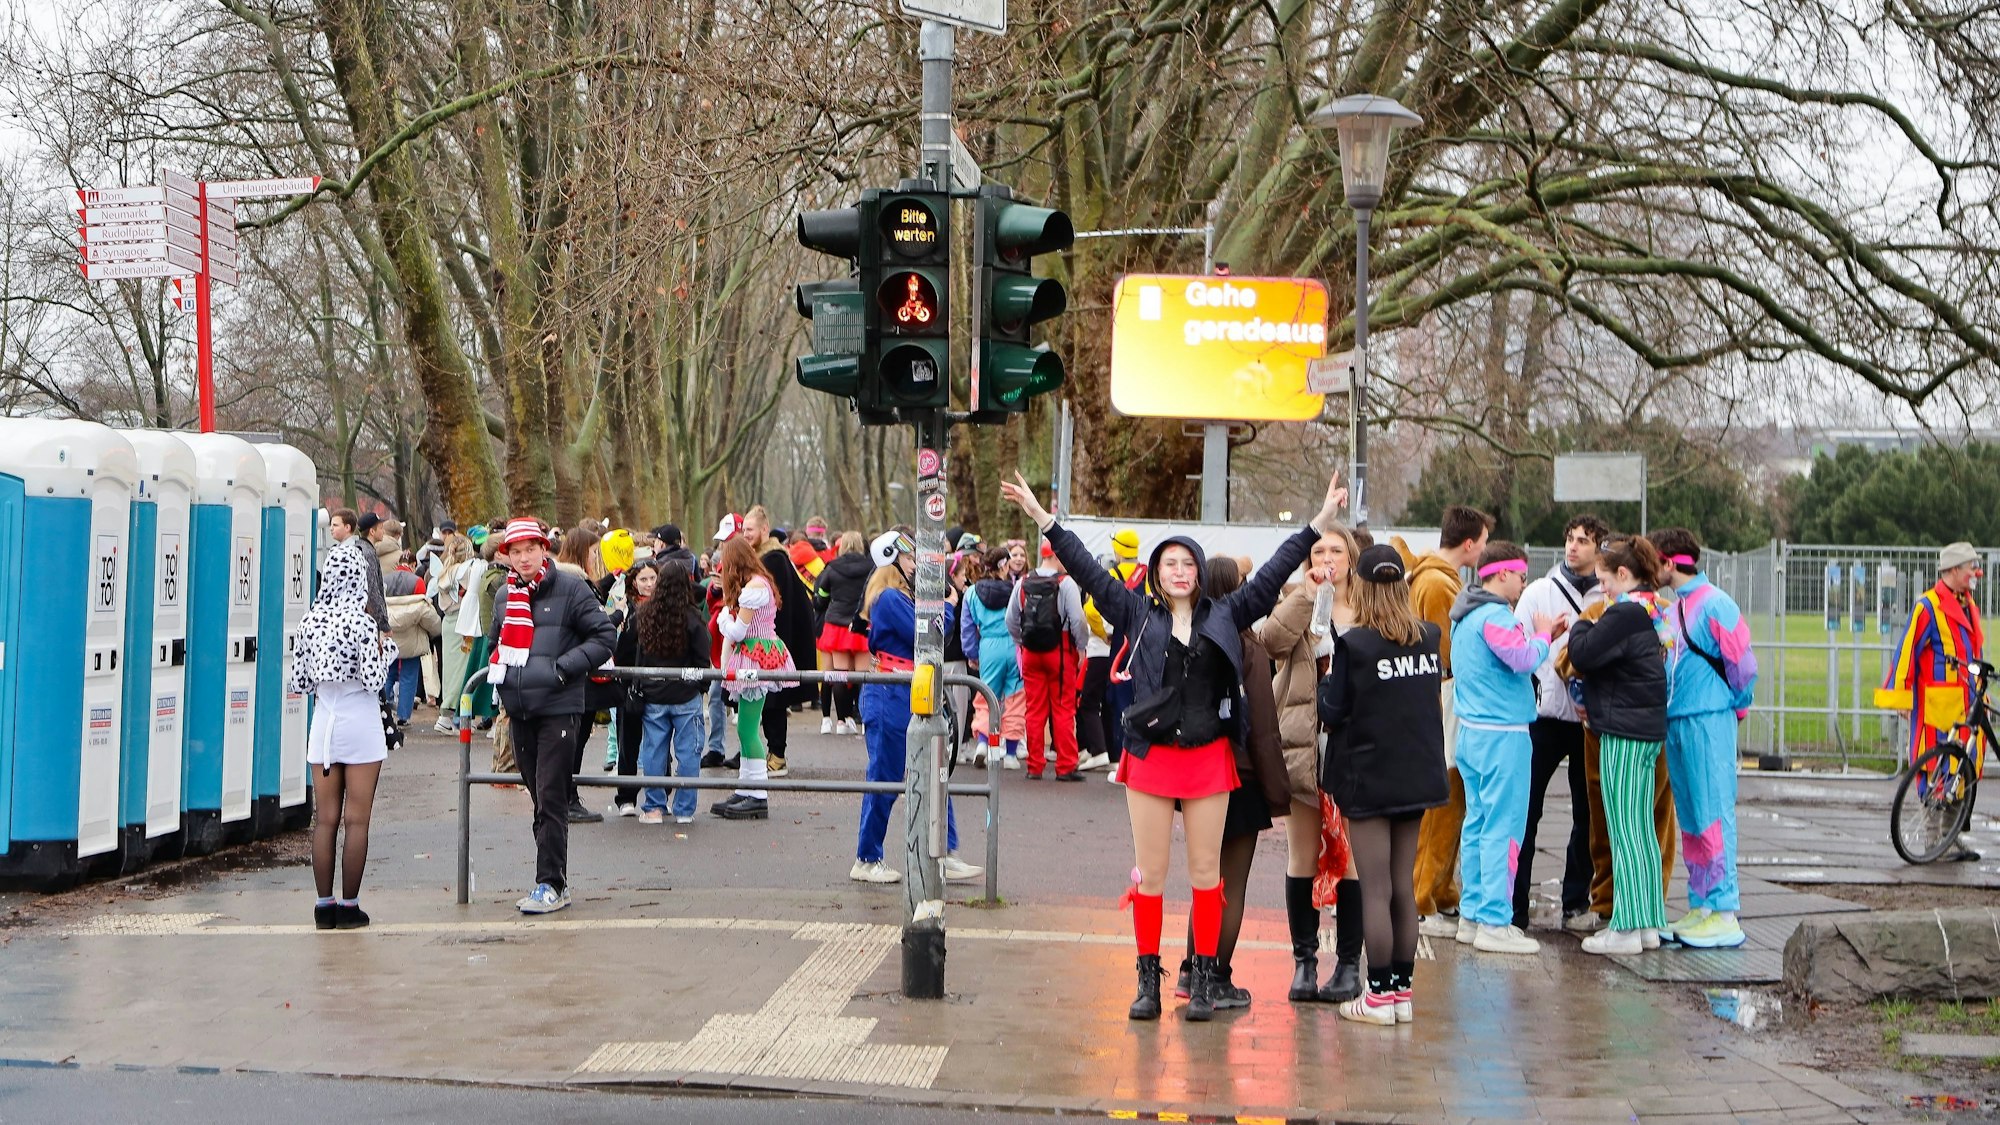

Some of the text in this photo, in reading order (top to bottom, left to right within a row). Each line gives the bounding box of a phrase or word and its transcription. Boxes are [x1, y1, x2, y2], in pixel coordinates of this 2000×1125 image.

[101, 192, 124, 201] Dom
[222, 180, 312, 195] Uni-Hauptgebäude
[101, 208, 149, 221] Neumarkt
[901, 209, 927, 224] Bitte
[102, 227, 155, 239] Rudolfplatz
[894, 229, 935, 242] warten
[103, 247, 149, 258] Synagoge
[103, 264, 170, 276] Rathenauplatz
[1185, 281, 1257, 308] Gehe
[1184, 317, 1325, 346] geradeaus
[102, 556, 115, 580] TOI
[166, 554, 178, 576] TOI
[240, 556, 251, 577] TOI
[293, 554, 303, 576] TOI
[101, 582, 114, 606] TOI
[165, 578, 177, 600] TOI
[240, 579, 250, 600] TOI
[293, 576, 302, 599] TOI
